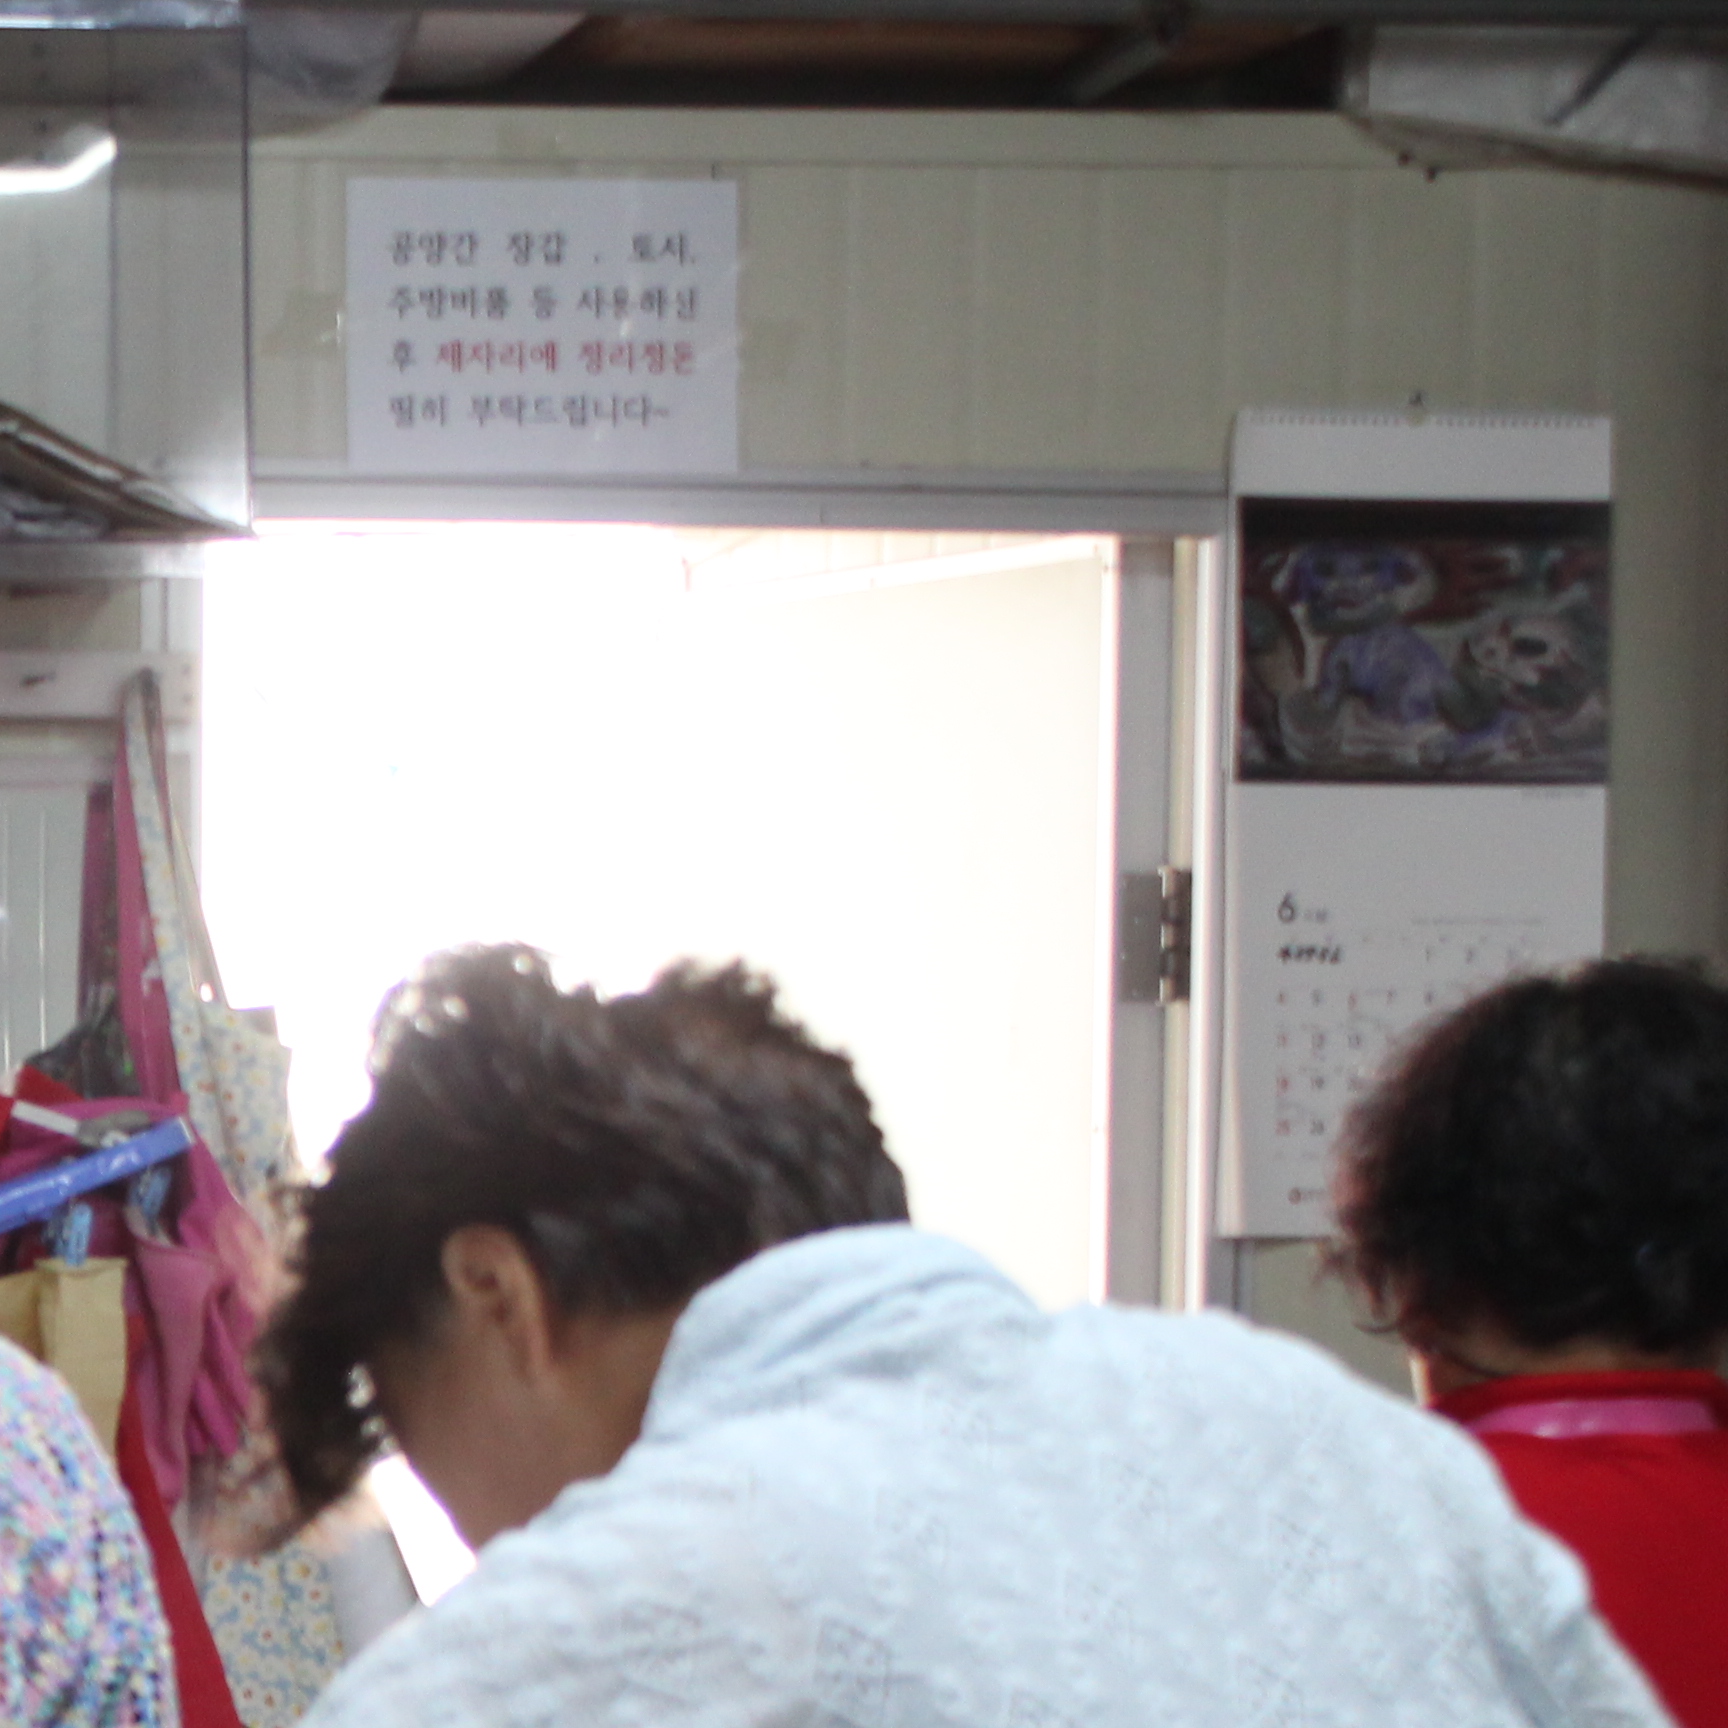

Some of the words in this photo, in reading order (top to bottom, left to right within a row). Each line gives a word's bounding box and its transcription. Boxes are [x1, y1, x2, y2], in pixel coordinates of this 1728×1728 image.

[388, 231, 480, 265] 공양간
[506, 231, 566, 265] 장갑
[388, 286, 510, 320] 주방비품
[531, 286, 557, 320] 등
[577, 286, 697, 321] 사용하신
[389, 340, 416, 374] 후
[436, 339, 558, 374] 제자리에
[578, 340, 696, 376] 정리정돈
[1277, 890, 1296, 924] 6
